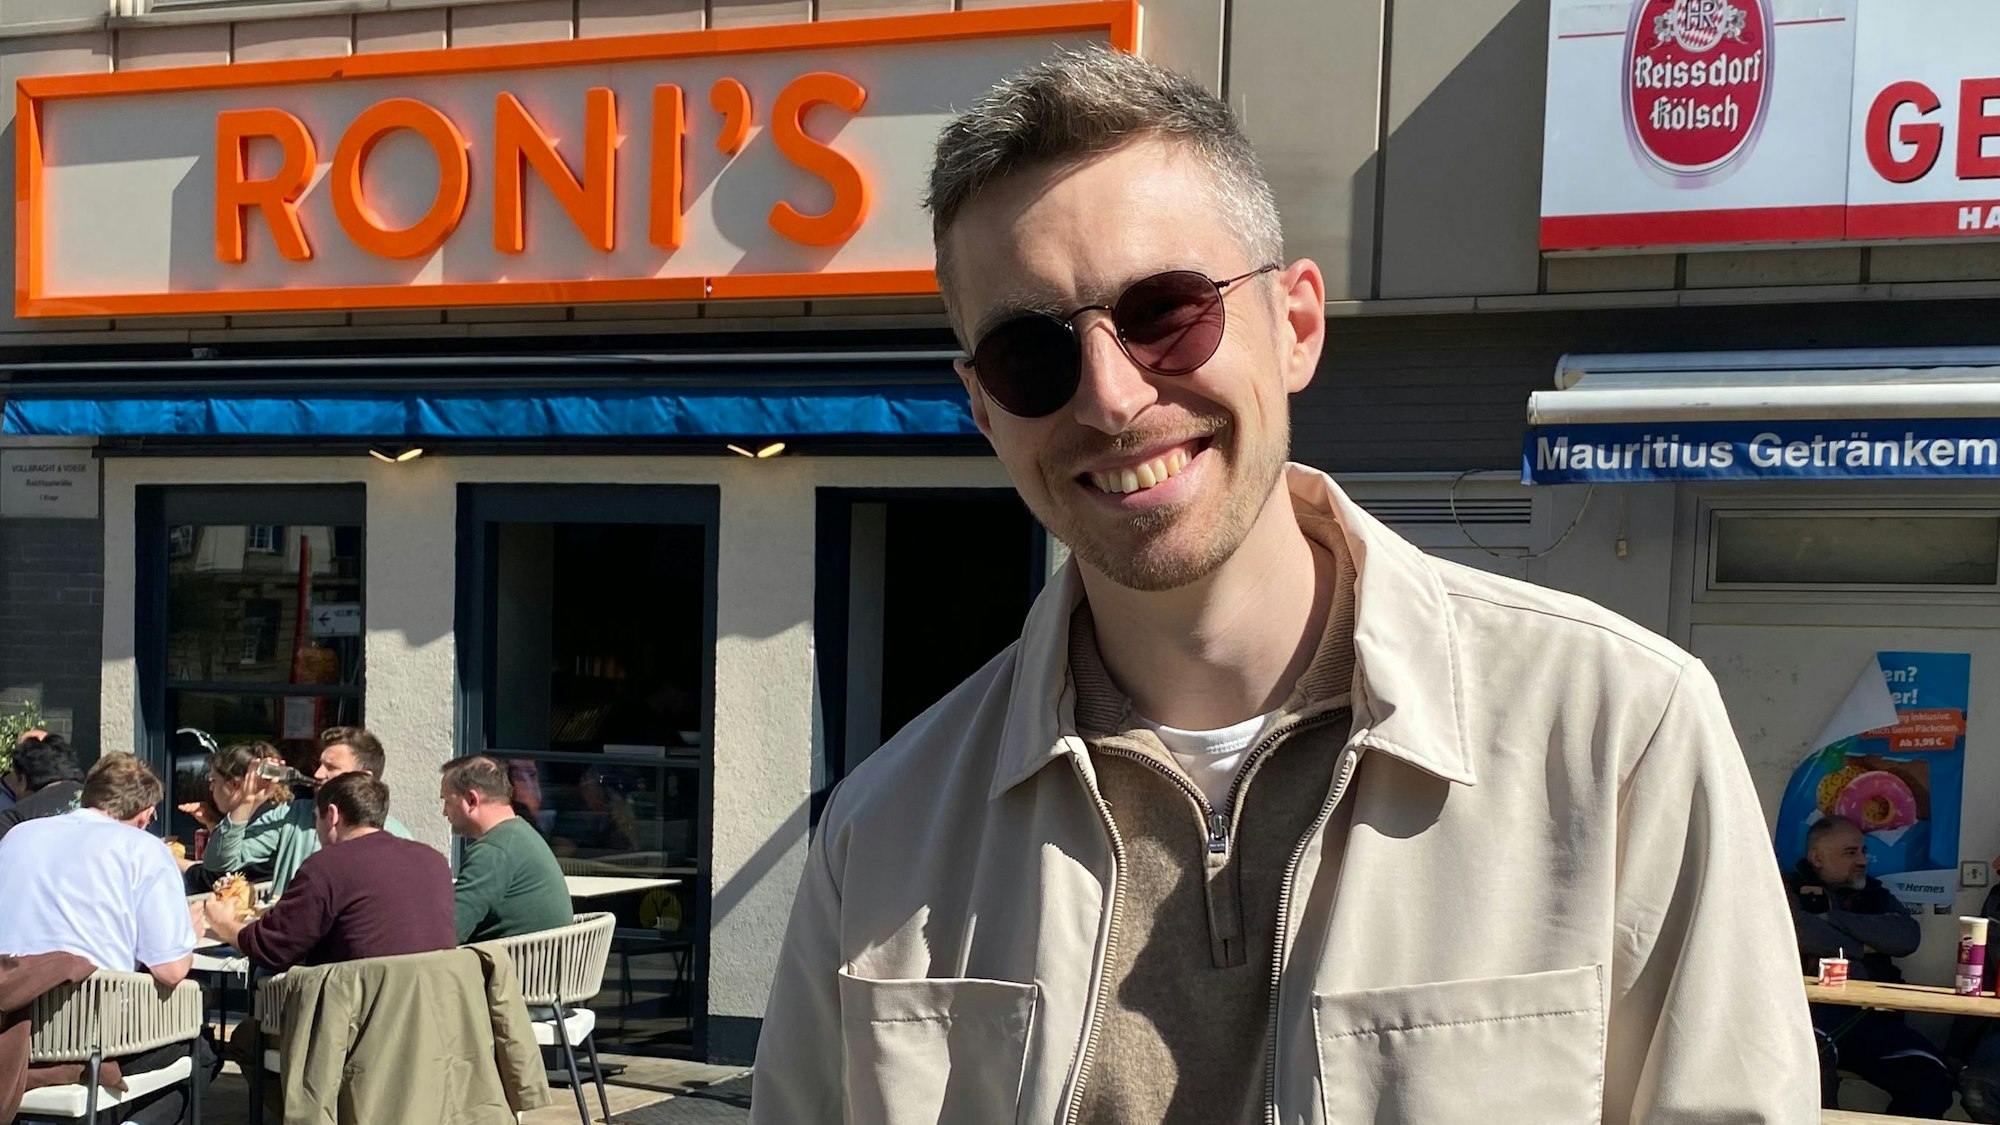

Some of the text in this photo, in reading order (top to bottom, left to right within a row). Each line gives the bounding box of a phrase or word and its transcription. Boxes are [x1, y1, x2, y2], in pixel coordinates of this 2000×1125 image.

[1634, 49, 1762, 90] Reissdorf
[1649, 94, 1740, 133] Kölsch
[1535, 431, 1998, 471] Mauritius Getränkem
[1899, 739, 1912, 747] Ab
[1914, 739, 1934, 747] 3,99
[1905, 883, 1945, 893] Hermes
